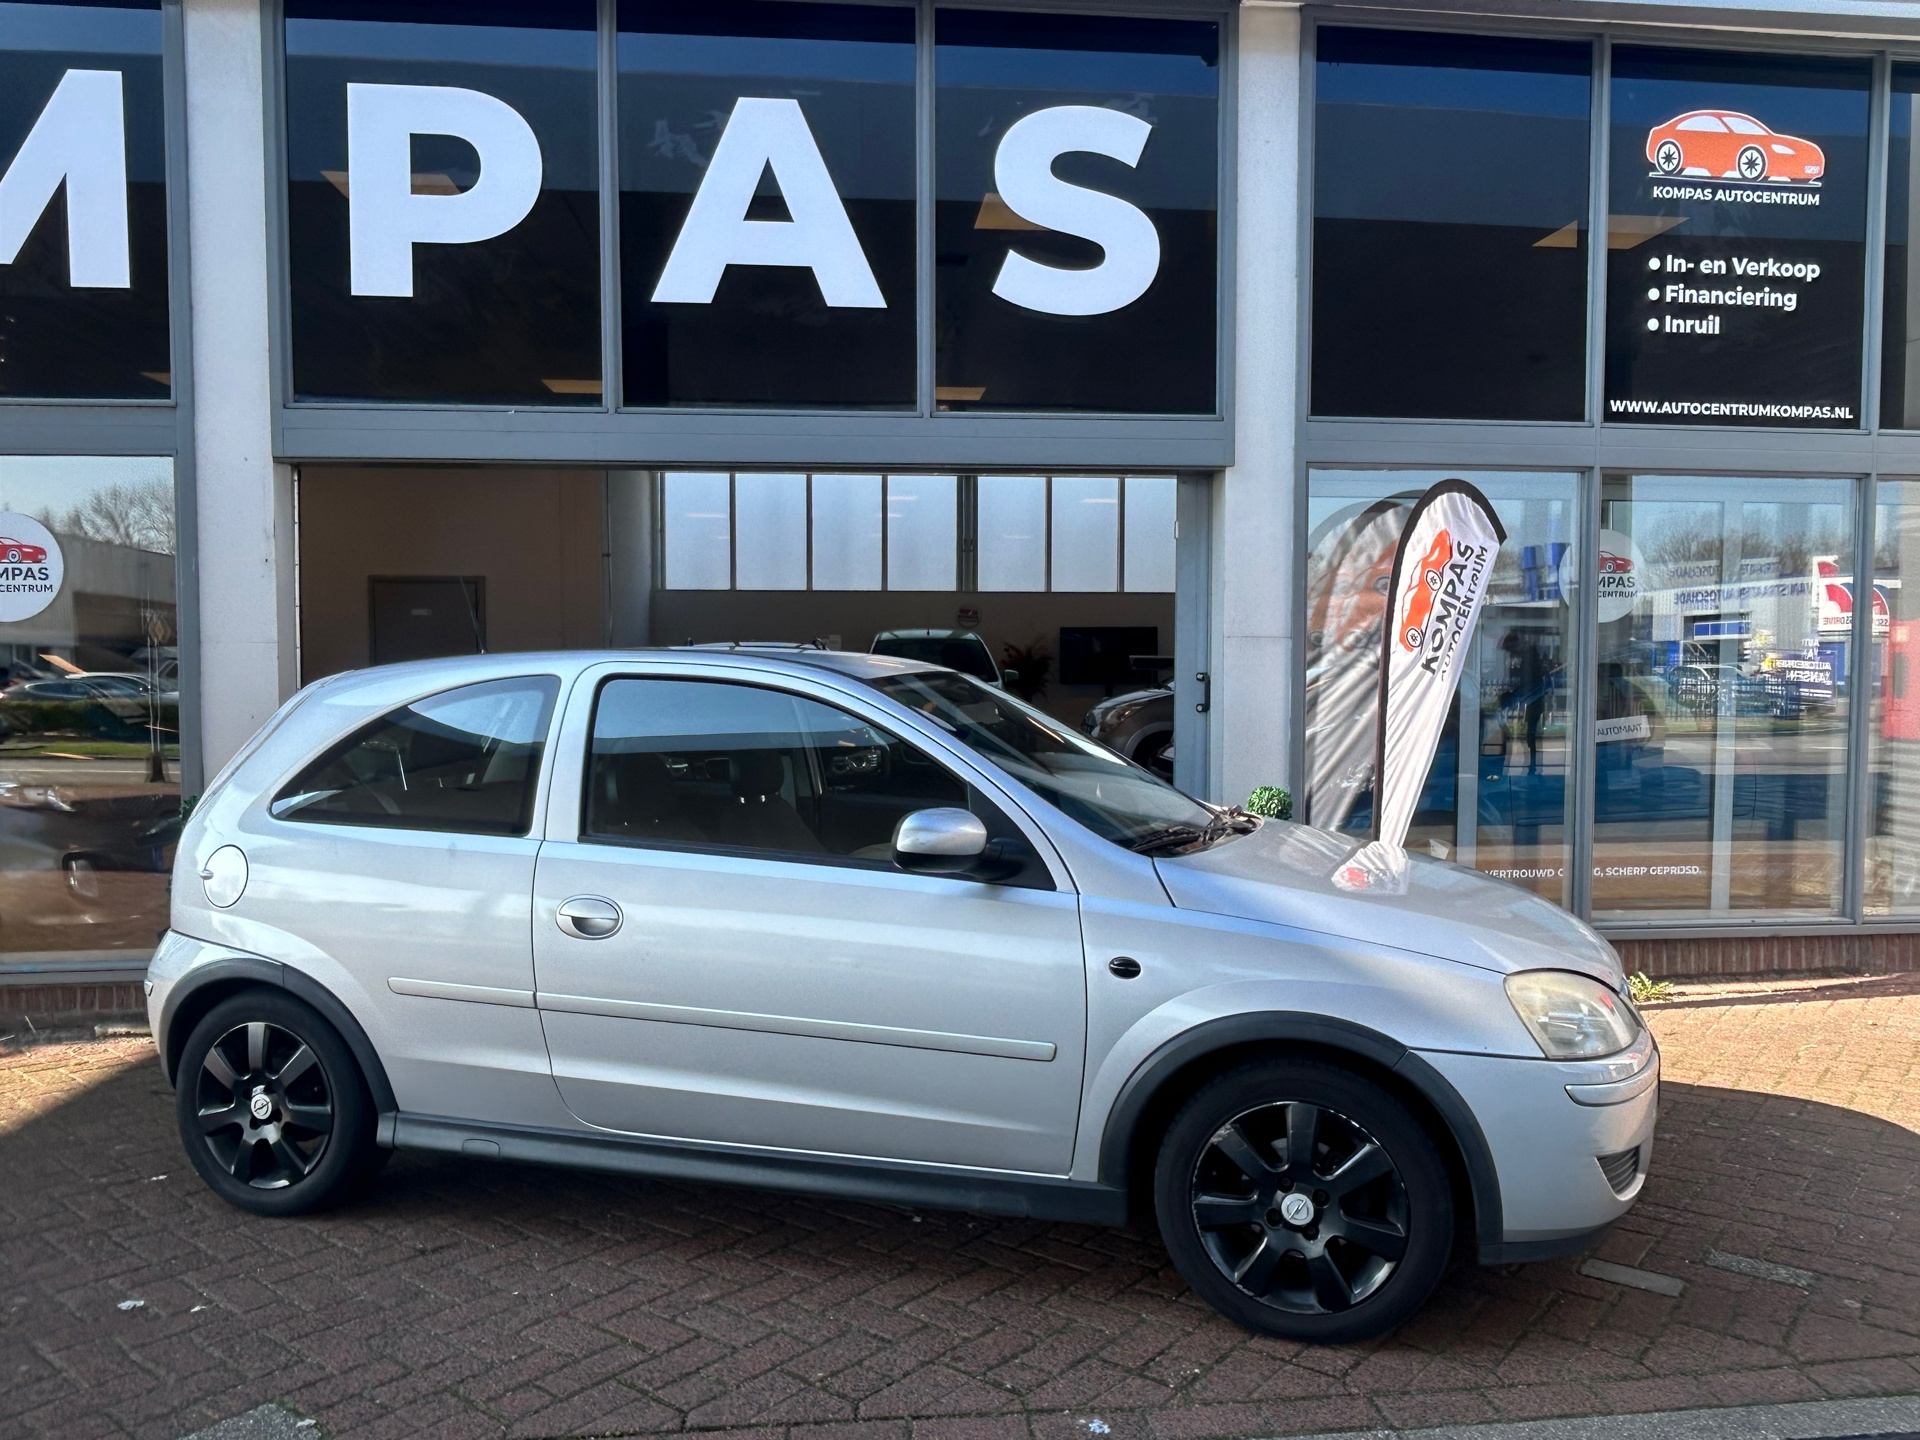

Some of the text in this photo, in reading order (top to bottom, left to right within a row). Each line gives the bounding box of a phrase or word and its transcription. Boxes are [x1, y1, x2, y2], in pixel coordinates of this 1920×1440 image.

[1653, 185, 1820, 206] KOMPAS AUTOCENTRUM
[1666, 255, 1821, 282] In- en Verkoop
[1665, 285, 1797, 310] Financiering
[1664, 315, 1720, 335] Inruil
[1610, 399, 1853, 419] WWW.AUTOCENTRUMKOMPAS.NL
[1420, 540, 1475, 676] KOMPAS
[1486, 868, 1555, 878] VERTROUWD
[1605, 866, 1647, 876] SCHERP
[1649, 865, 1703, 876] GEPRIJSD.
